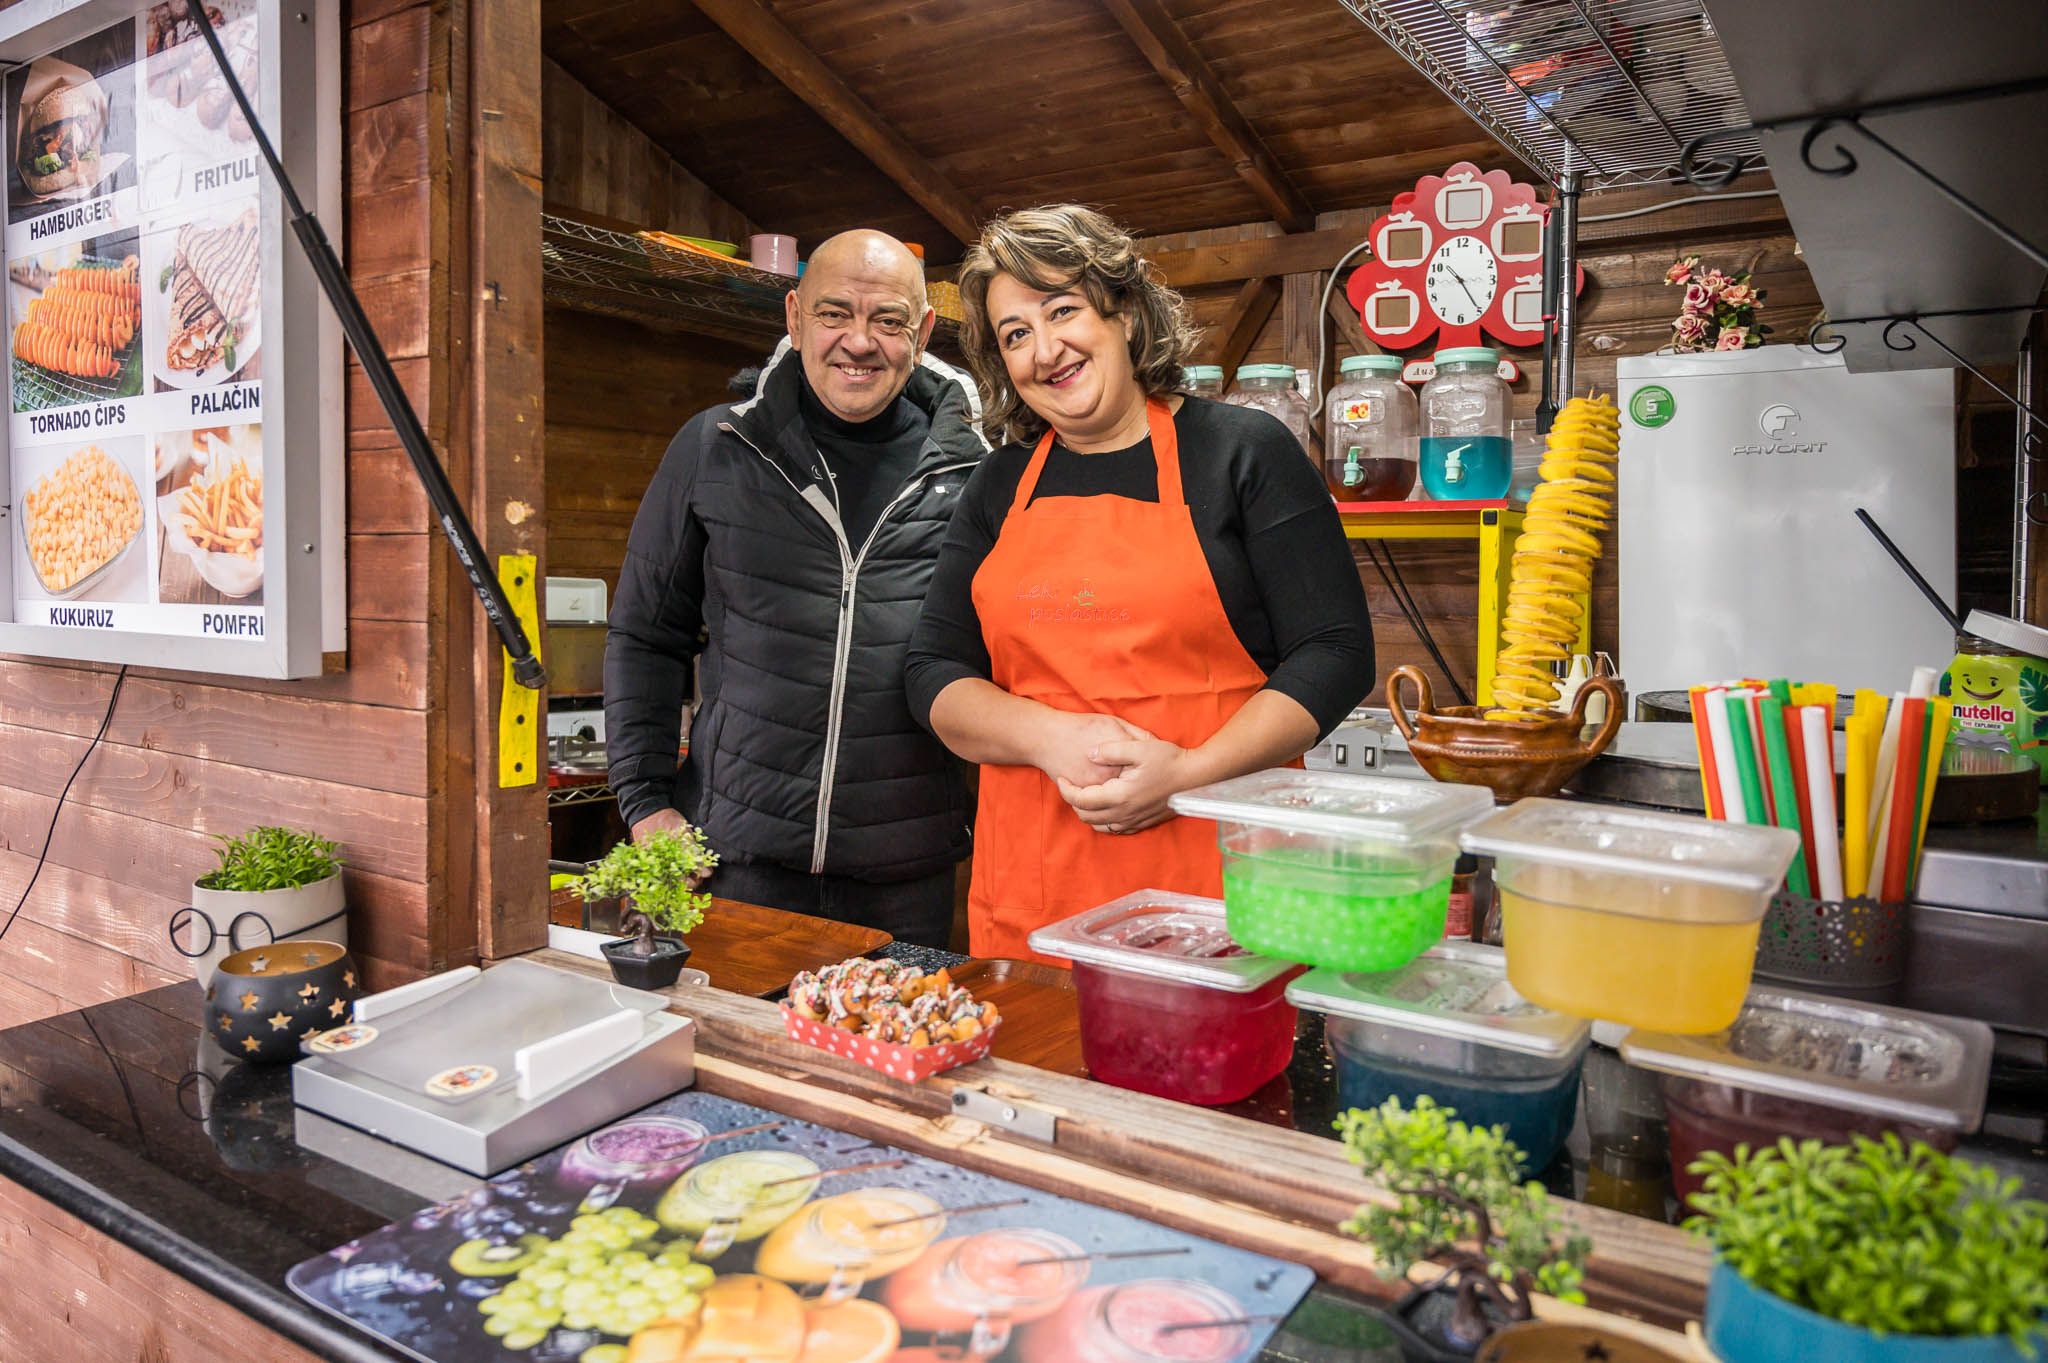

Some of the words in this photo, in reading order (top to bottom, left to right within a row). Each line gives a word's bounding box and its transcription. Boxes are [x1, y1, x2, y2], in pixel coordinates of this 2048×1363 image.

[30, 199, 112, 241] HAMBURGER
[1456, 237, 1469, 248] 12
[1440, 247, 1450, 257] 11
[1478, 245, 1484, 254] 1
[1432, 263, 1443, 273] 10
[1487, 259, 1494, 269] 2
[1428, 277, 1435, 288] 9
[1489, 274, 1496, 286] 3
[1430, 292, 1438, 302] 8
[1486, 290, 1492, 300] 4
[1440, 307, 1446, 317] 7
[1476, 306, 1483, 316] 5
[1457, 313, 1464, 324] 6
[192, 385, 260, 415] PALAČIN
[1646, 399, 1657, 414] 5
[30, 408, 91, 434] TORNADO
[94, 402, 126, 426] ČIPS
[1733, 442, 1828, 456] FAVORIT
[50, 607, 114, 628] KUKURUZ
[203, 613, 264, 636] POMFRI
[1953, 704, 2014, 723] nutella
